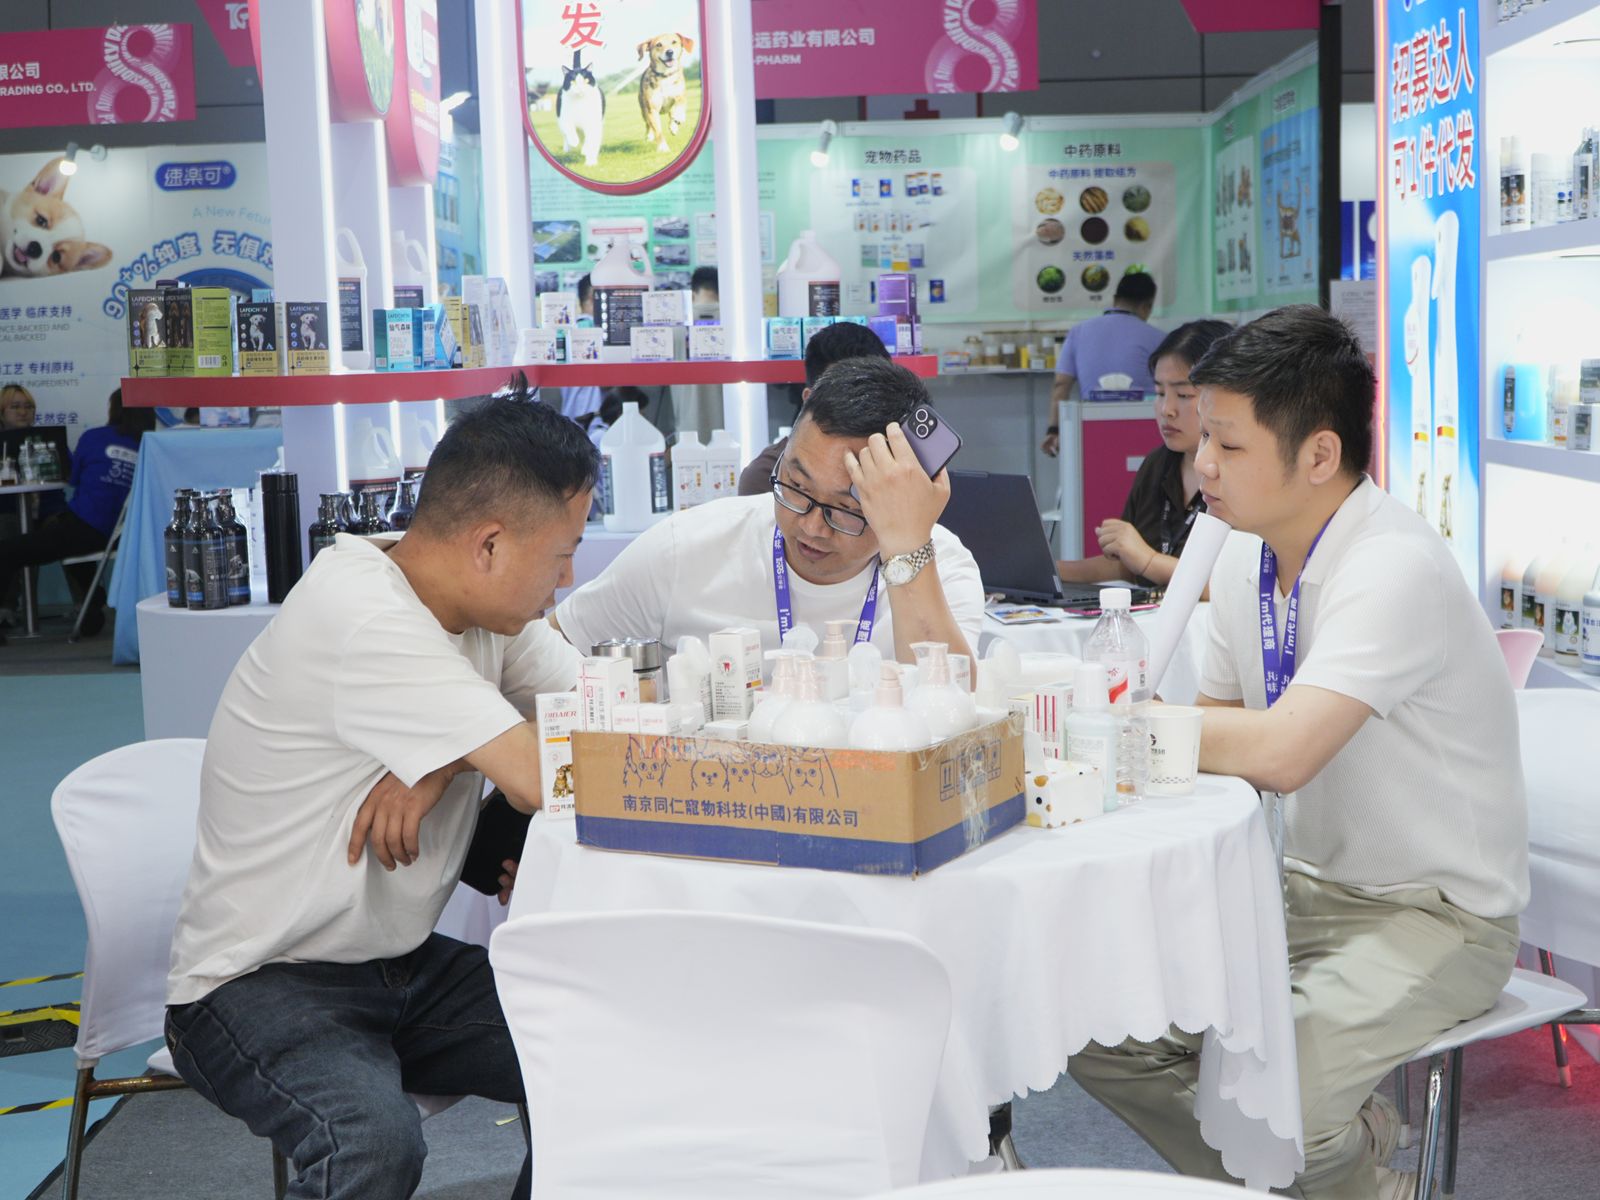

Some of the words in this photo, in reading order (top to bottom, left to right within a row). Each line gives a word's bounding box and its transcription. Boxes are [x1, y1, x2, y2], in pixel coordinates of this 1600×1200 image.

[560, 3, 603, 48] 发
[1392, 9, 1474, 124] 招募达人
[46, 83, 69, 95] CO.,
[71, 81, 97, 93] LTD.
[865, 149, 922, 164] 宠物药品
[1393, 110, 1475, 200] 可1件代发
[206, 206, 236, 217] New
[0, 362, 24, 376] 工艺
[622, 795, 858, 828] 南京同仁寵物科技(中國)有限公司
